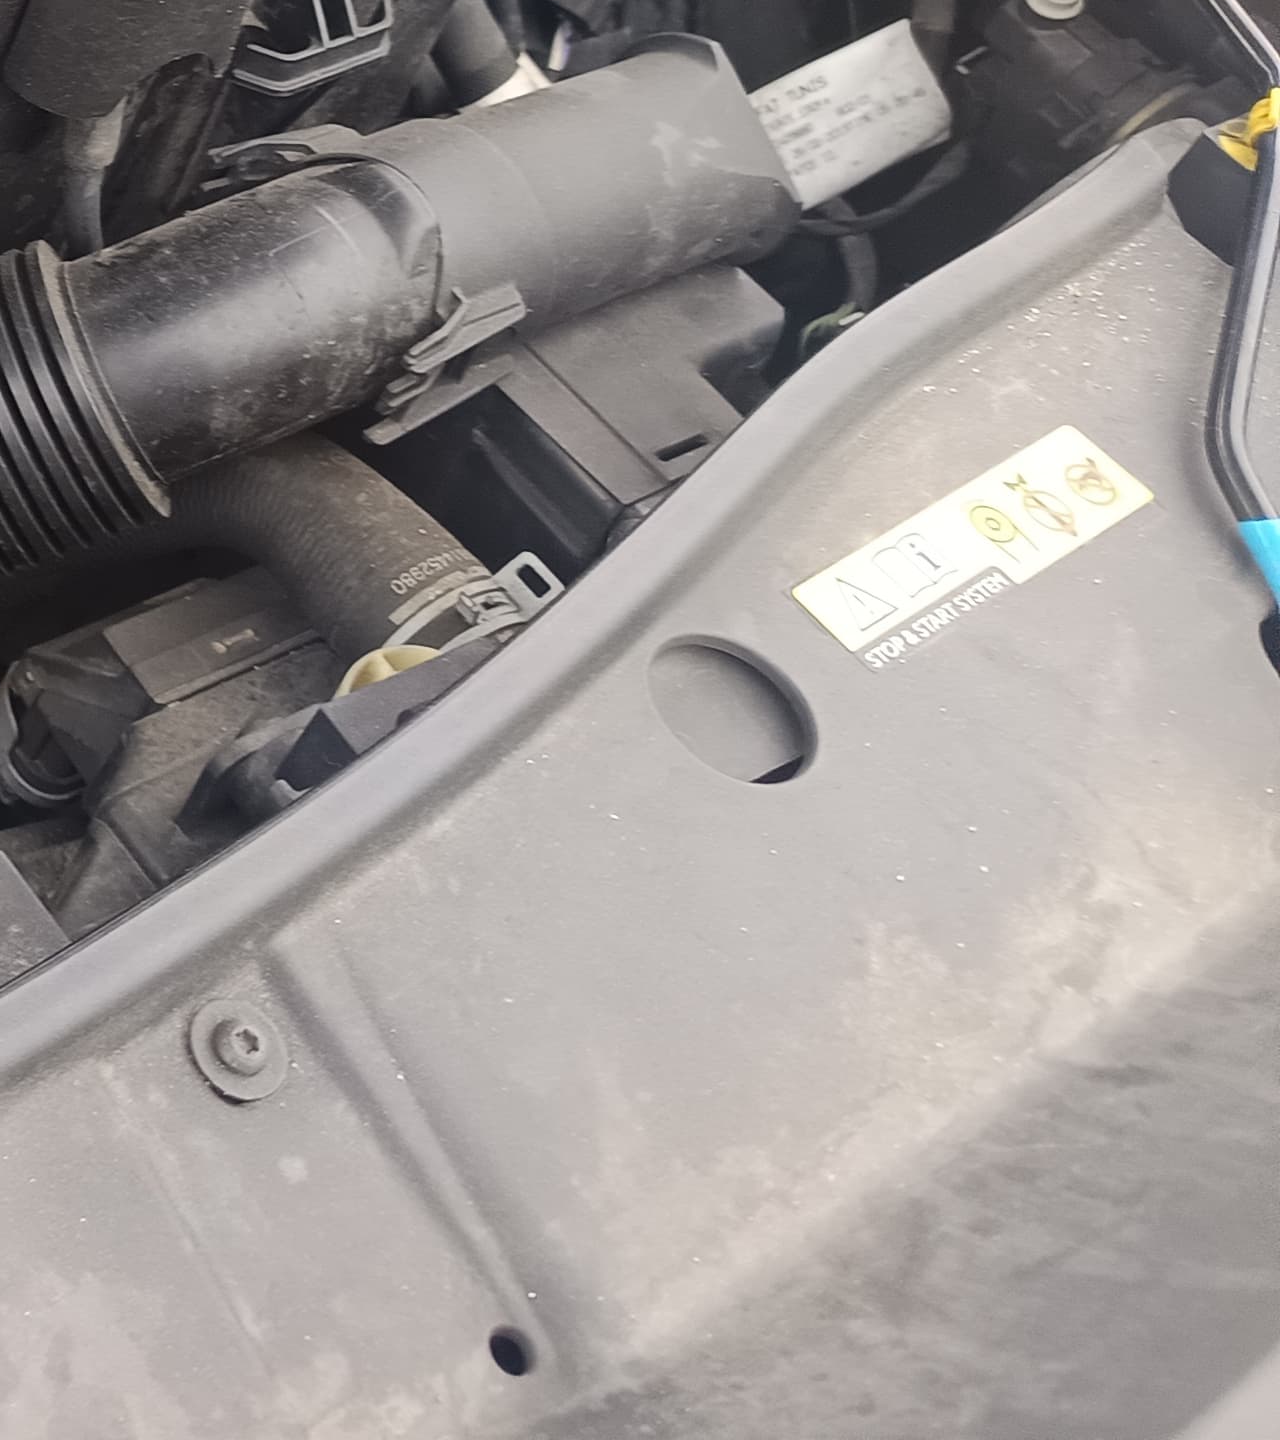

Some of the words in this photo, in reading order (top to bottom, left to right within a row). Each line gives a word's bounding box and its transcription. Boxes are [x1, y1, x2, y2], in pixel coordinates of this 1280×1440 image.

[864, 635, 906, 669] STOP
[900, 629, 922, 646] &
[911, 602, 960, 638] START
[953, 571, 1010, 612] SYSTEM
